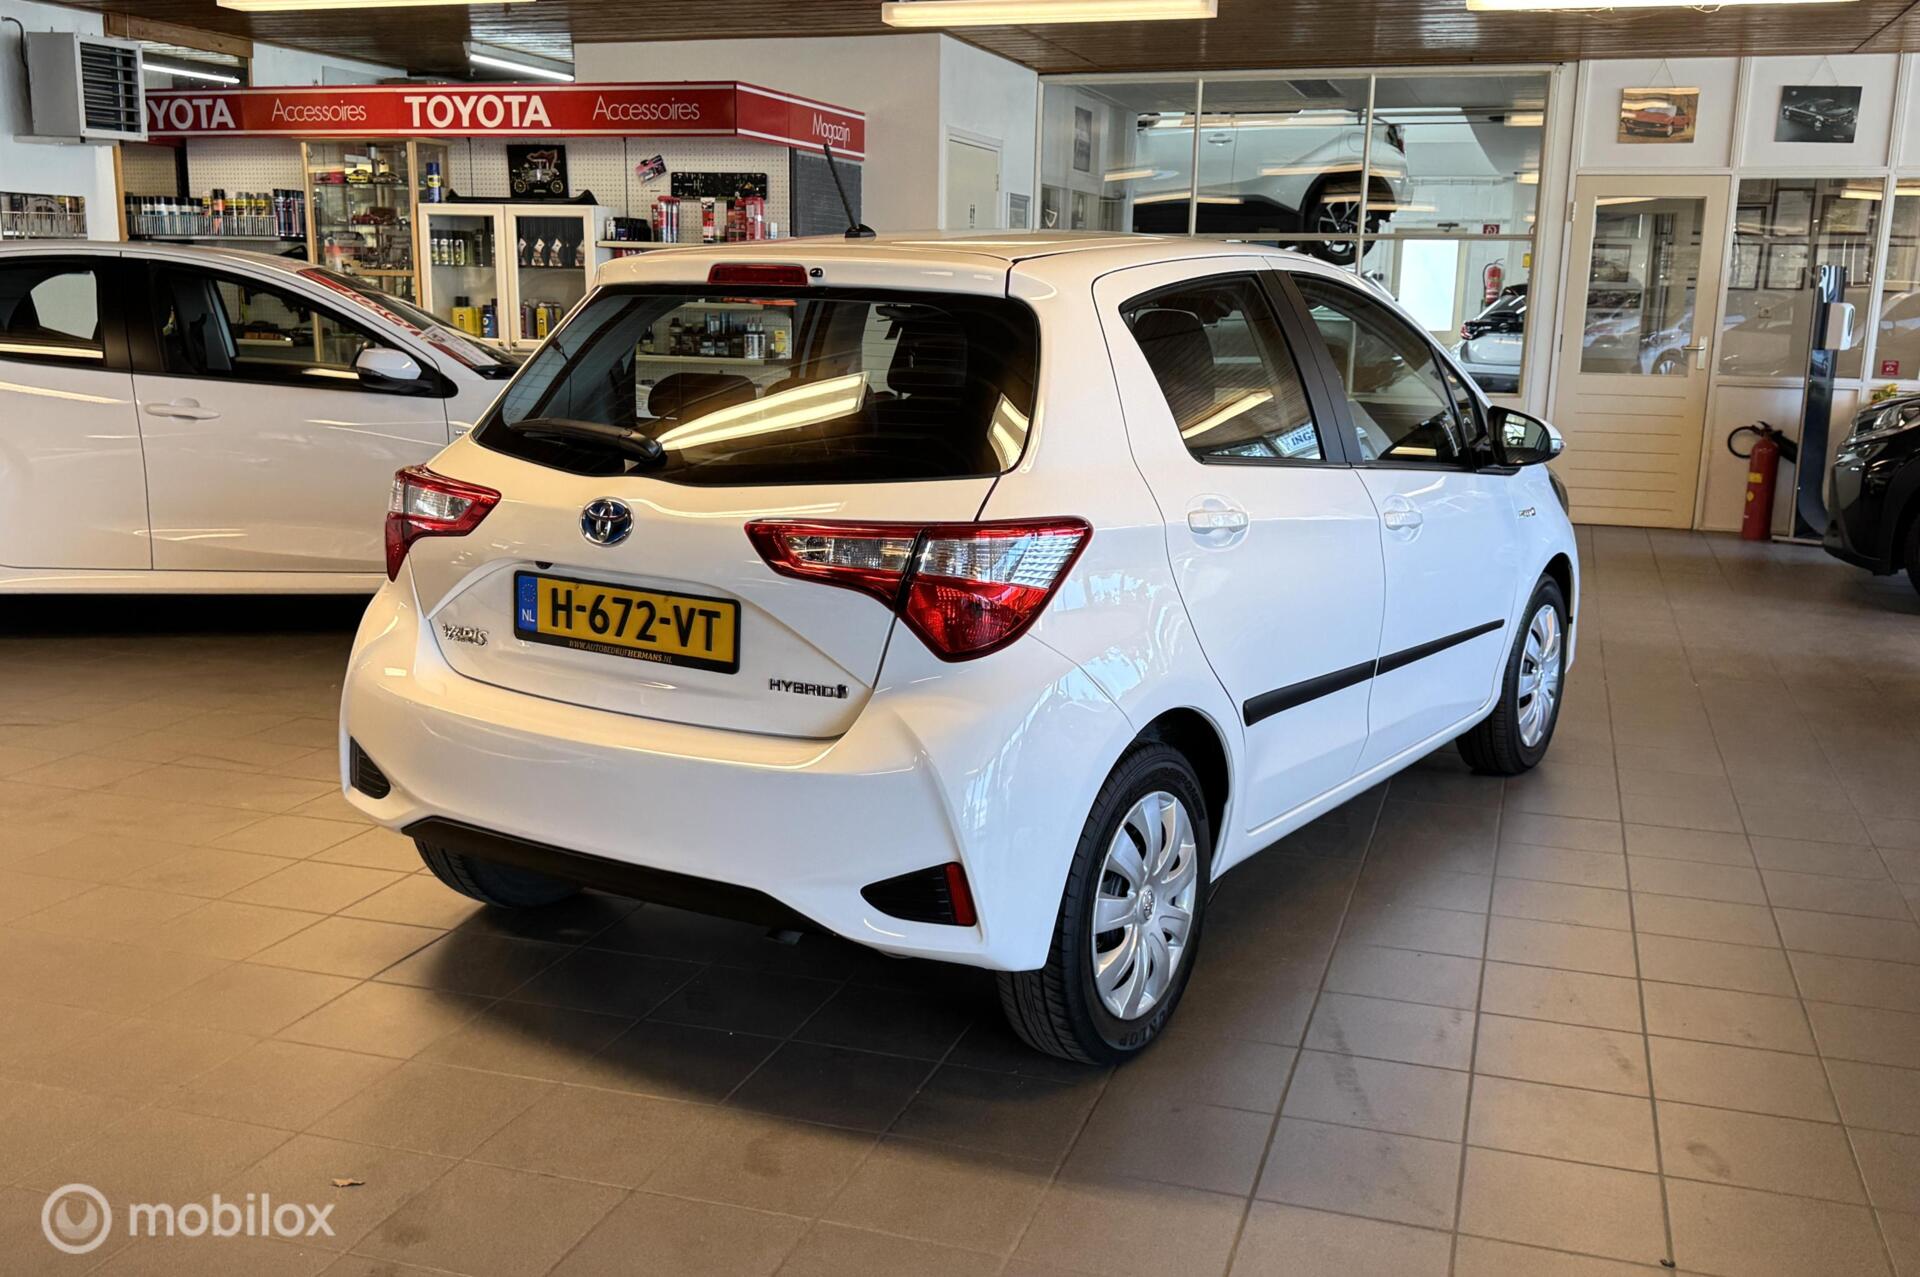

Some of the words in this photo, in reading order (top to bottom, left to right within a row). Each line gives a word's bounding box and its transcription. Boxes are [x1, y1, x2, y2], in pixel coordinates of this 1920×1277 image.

[147, 98, 236, 129] YOTA
[271, 98, 367, 121] Accessoires
[404, 95, 552, 128] TOYOTA
[592, 96, 700, 121] Accessoires
[812, 112, 850, 148] Magazijn
[521, 608, 535, 622] NL
[551, 587, 721, 651] H-672-VT
[769, 678, 835, 698] HYBRID
